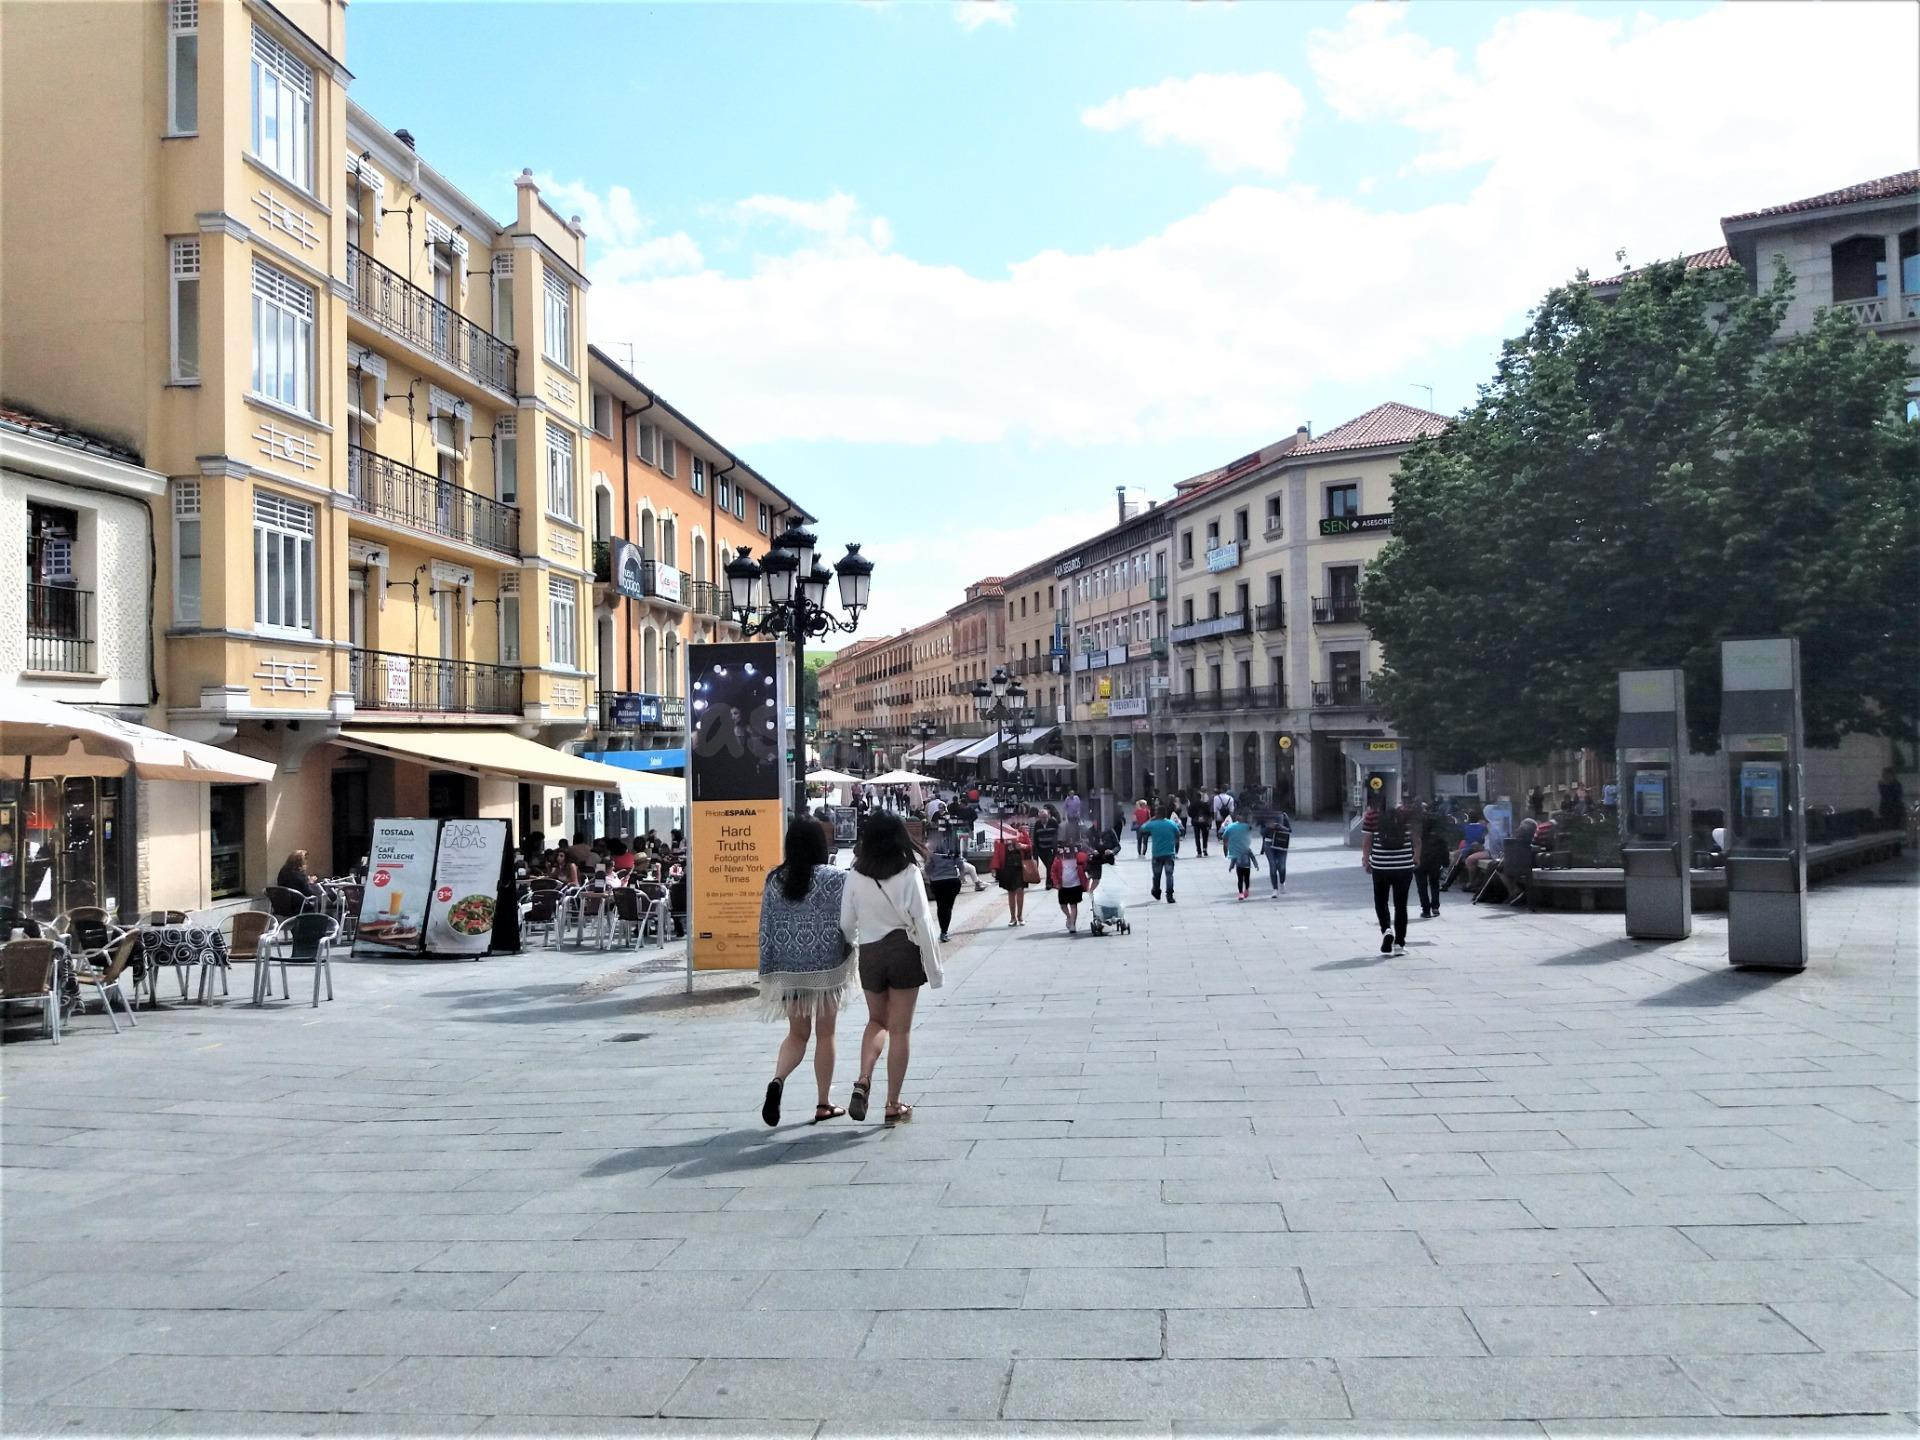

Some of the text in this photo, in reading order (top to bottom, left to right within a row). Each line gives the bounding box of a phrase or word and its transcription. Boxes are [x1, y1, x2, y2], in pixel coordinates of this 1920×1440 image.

[1323, 520, 1349, 533] SEN
[446, 824, 480, 837] ENSA
[721, 825, 752, 837] Hard
[443, 836, 487, 849] LADAS
[716, 840, 757, 851] Truths
[714, 853, 759, 864] Fotógrafos
[709, 864, 765, 873] del New York
[724, 874, 750, 883] Times
